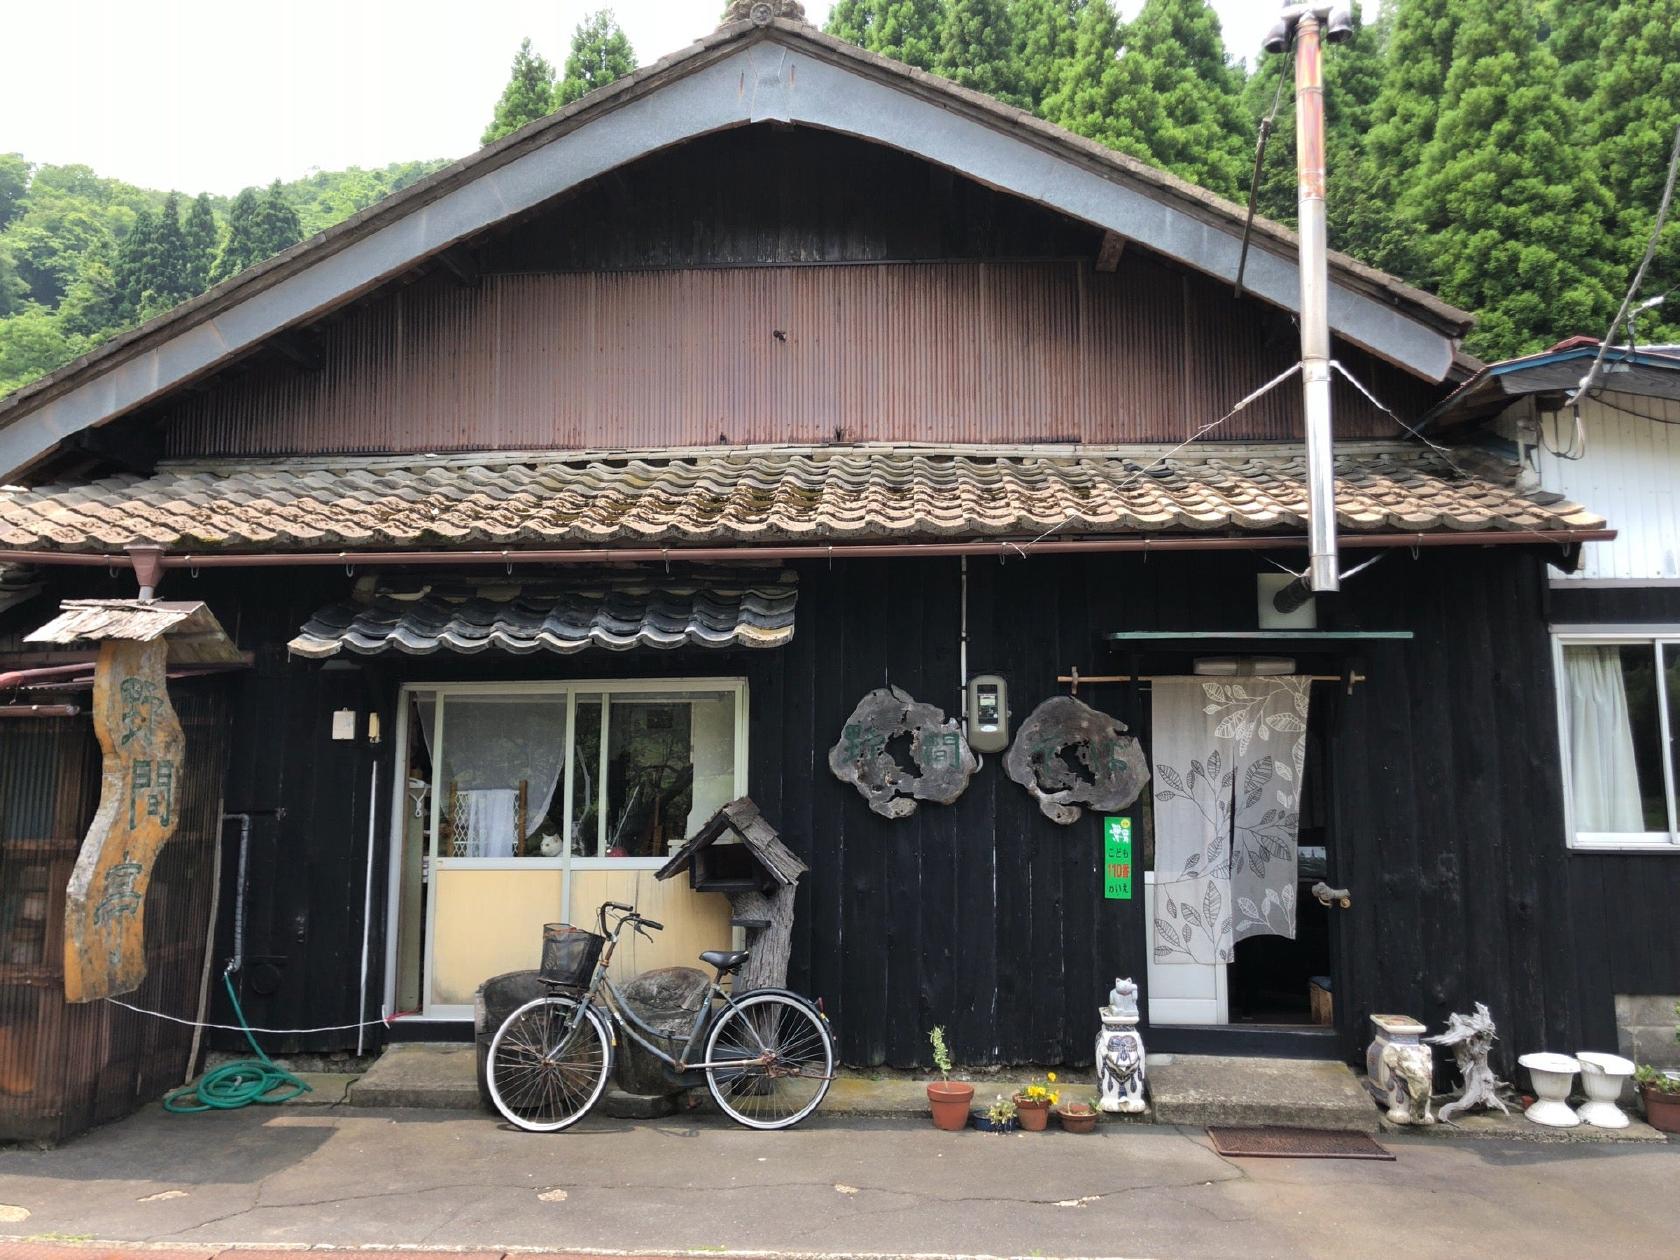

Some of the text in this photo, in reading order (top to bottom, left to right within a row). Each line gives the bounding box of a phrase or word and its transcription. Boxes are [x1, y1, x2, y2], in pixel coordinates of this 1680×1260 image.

[94, 677, 174, 965] 野間亭
[1108, 848, 1129, 859] こども
[1108, 864, 1129, 879] 110番
